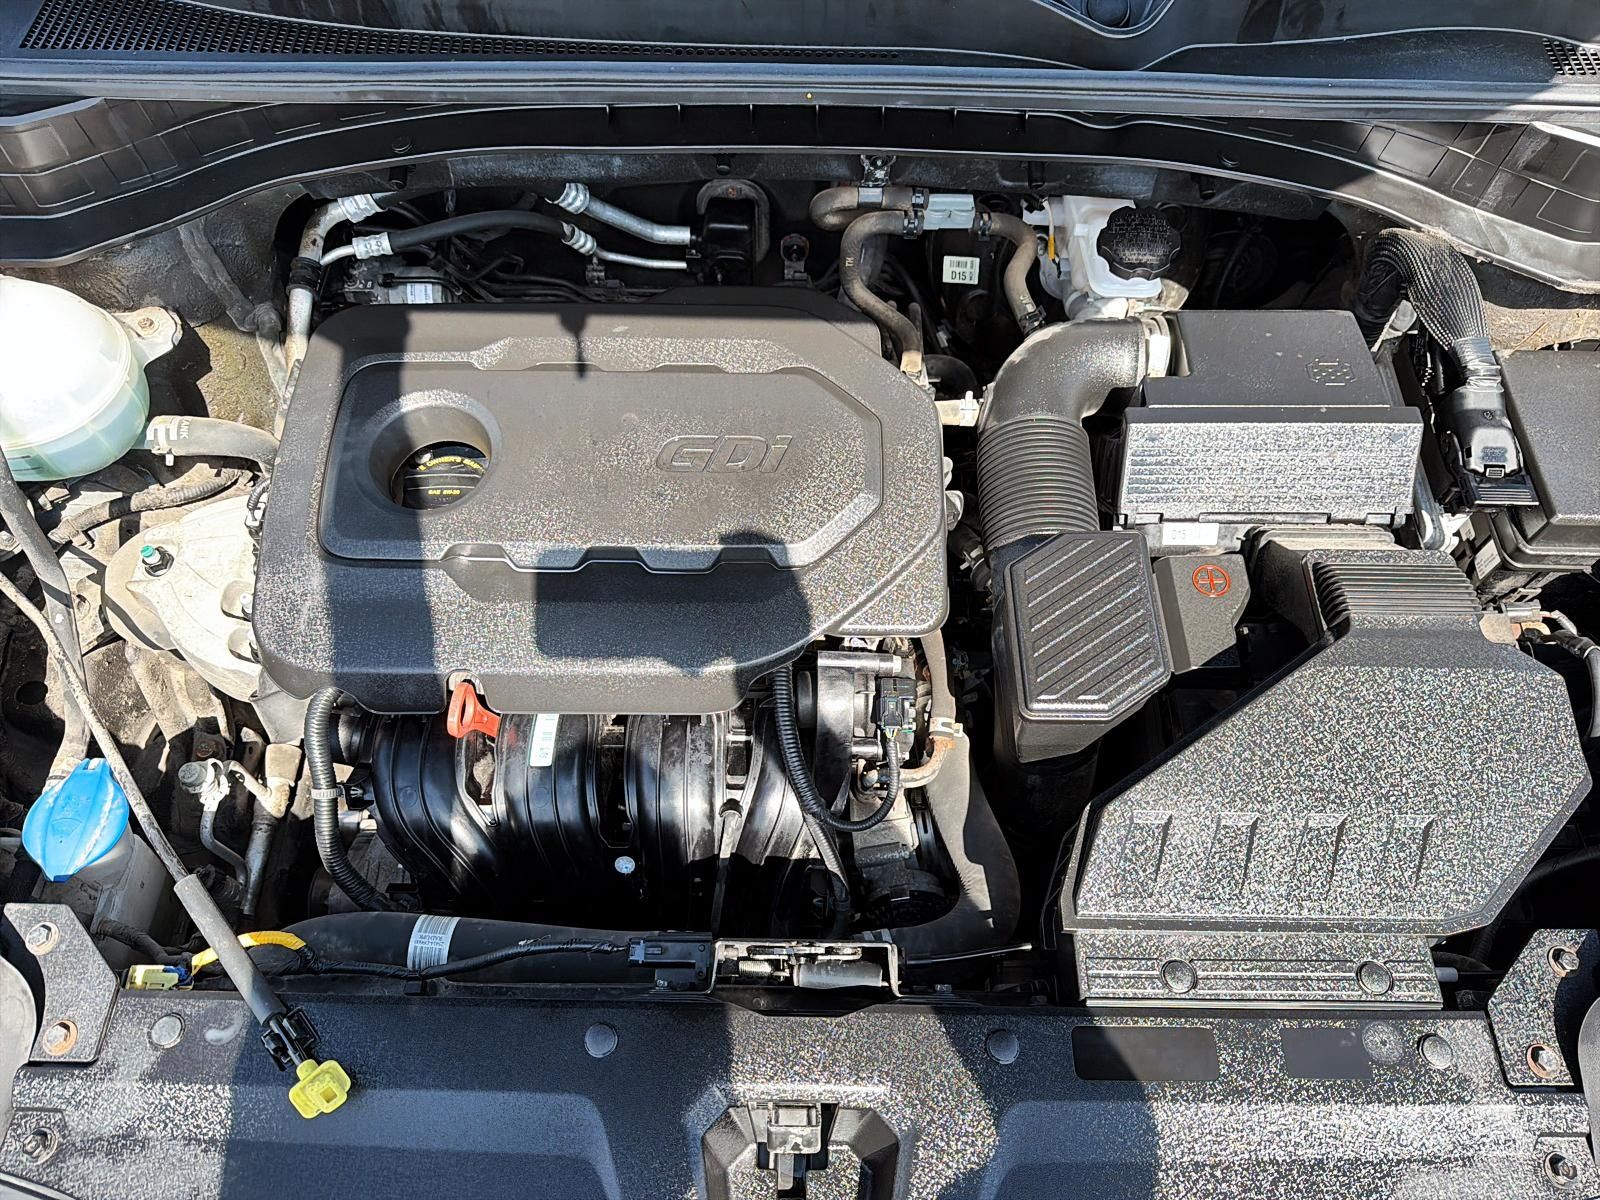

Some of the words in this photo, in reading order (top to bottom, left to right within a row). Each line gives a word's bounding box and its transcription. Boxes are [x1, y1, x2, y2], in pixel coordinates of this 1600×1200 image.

[951, 270, 967, 281] D15
[656, 434, 793, 473] GDi
[426, 456, 462, 467] OWNER'S
